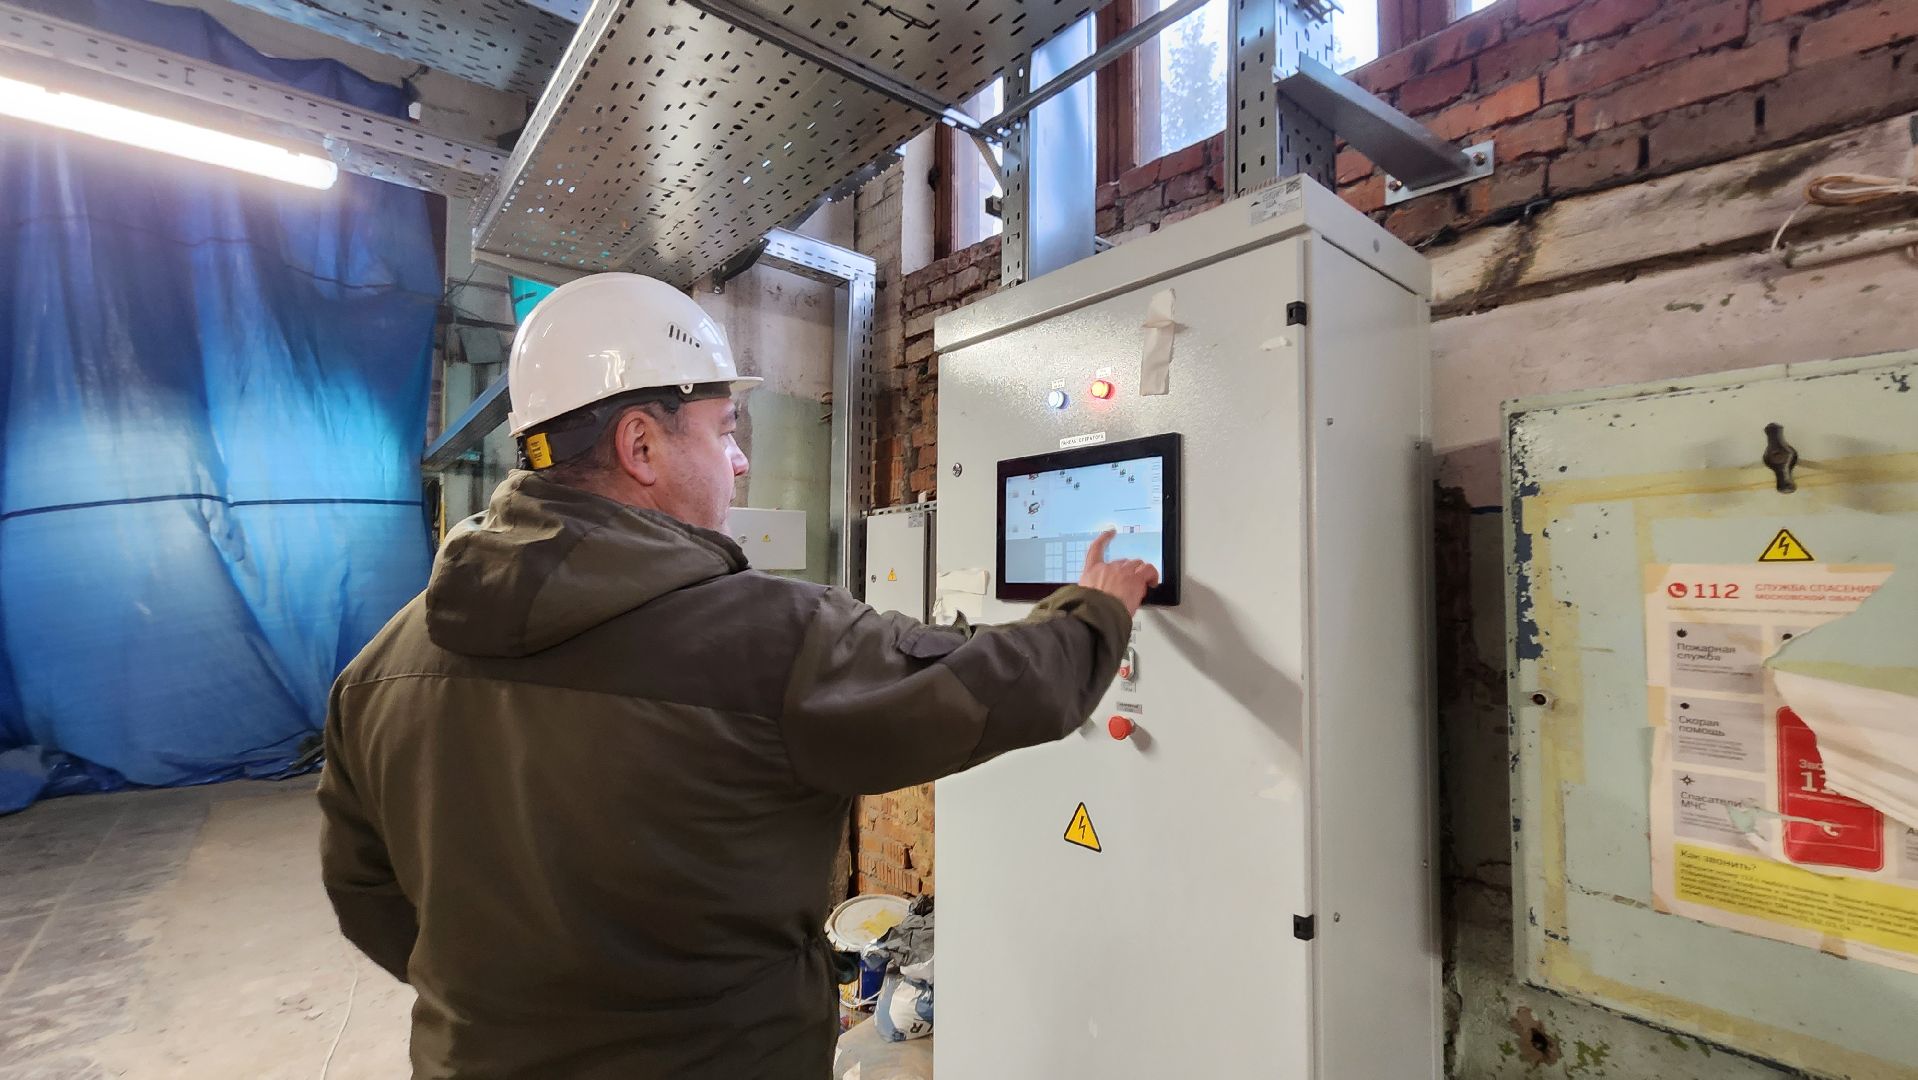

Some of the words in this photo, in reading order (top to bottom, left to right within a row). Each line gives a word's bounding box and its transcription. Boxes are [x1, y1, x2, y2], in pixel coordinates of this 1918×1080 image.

[1694, 583, 1739, 599] 112
[1754, 584, 1807, 592] СЛУЖБА
[1755, 593, 1825, 602] МОСКОВСКОЙ
[1677, 642, 1736, 655] Пожарная
[1677, 652, 1721, 662] служба
[1679, 715, 1720, 727] Скорая
[1679, 725, 1726, 736] помощь
[1680, 791, 1743, 808] Спасатели
[1680, 799, 1706, 811] МЧС
[1680, 850, 1699, 860] Как
[1703, 855, 1757, 871] звонить?
